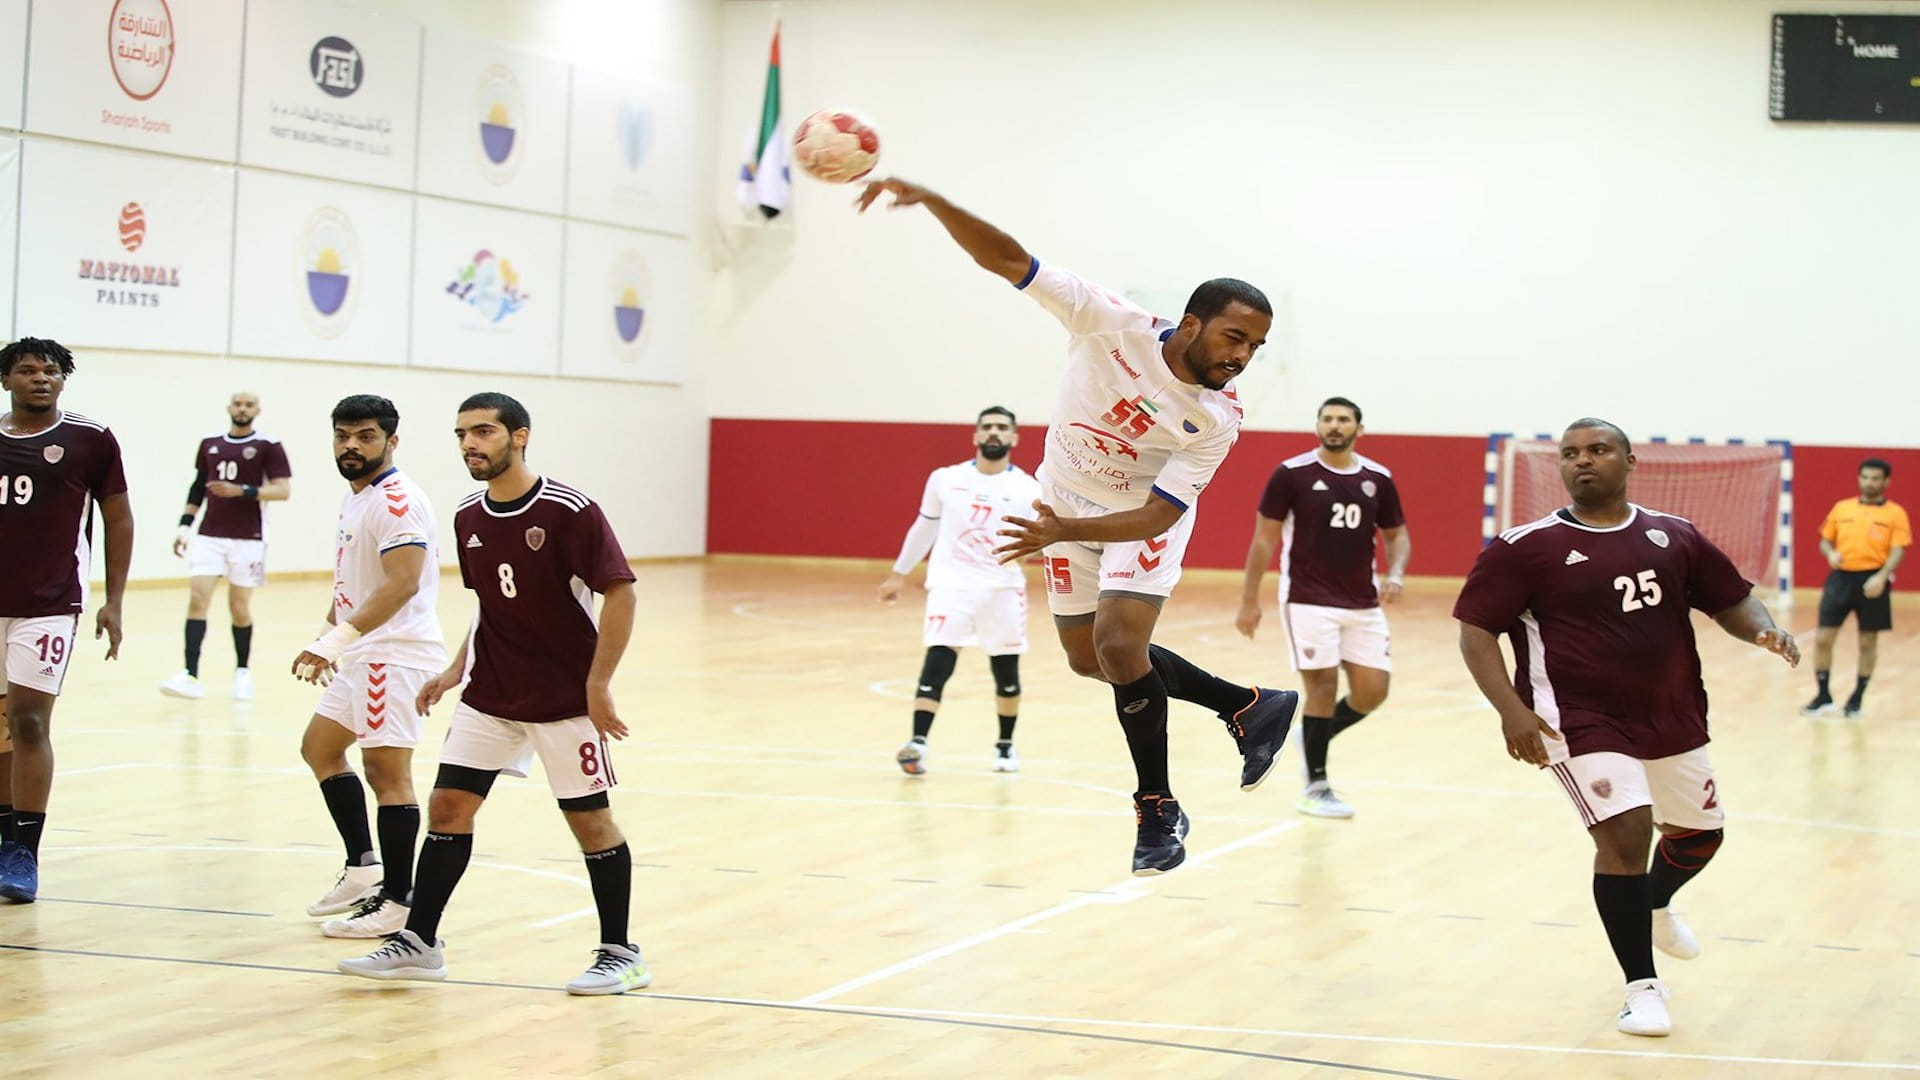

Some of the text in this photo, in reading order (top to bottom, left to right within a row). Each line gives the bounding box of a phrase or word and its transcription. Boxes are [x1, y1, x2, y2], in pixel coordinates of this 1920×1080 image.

[119, 11, 166, 39] الشارقة
[117, 39, 166, 68] الرياضية
[1853, 43, 1899, 59] HOME
[79, 259, 181, 287] NATIONAL
[96, 289, 160, 308] PAINTS
[1110, 347, 1142, 380] hummel
[1100, 397, 1157, 440] 55
[216, 460, 238, 481] 10
[0, 474, 34, 505] 19
[970, 503, 993, 525] 77
[1330, 502, 1362, 529] 20
[497, 562, 517, 599] 8
[1613, 569, 1663, 613] 25
[36, 633, 65, 665] 19
[578, 741, 599, 776] 8
